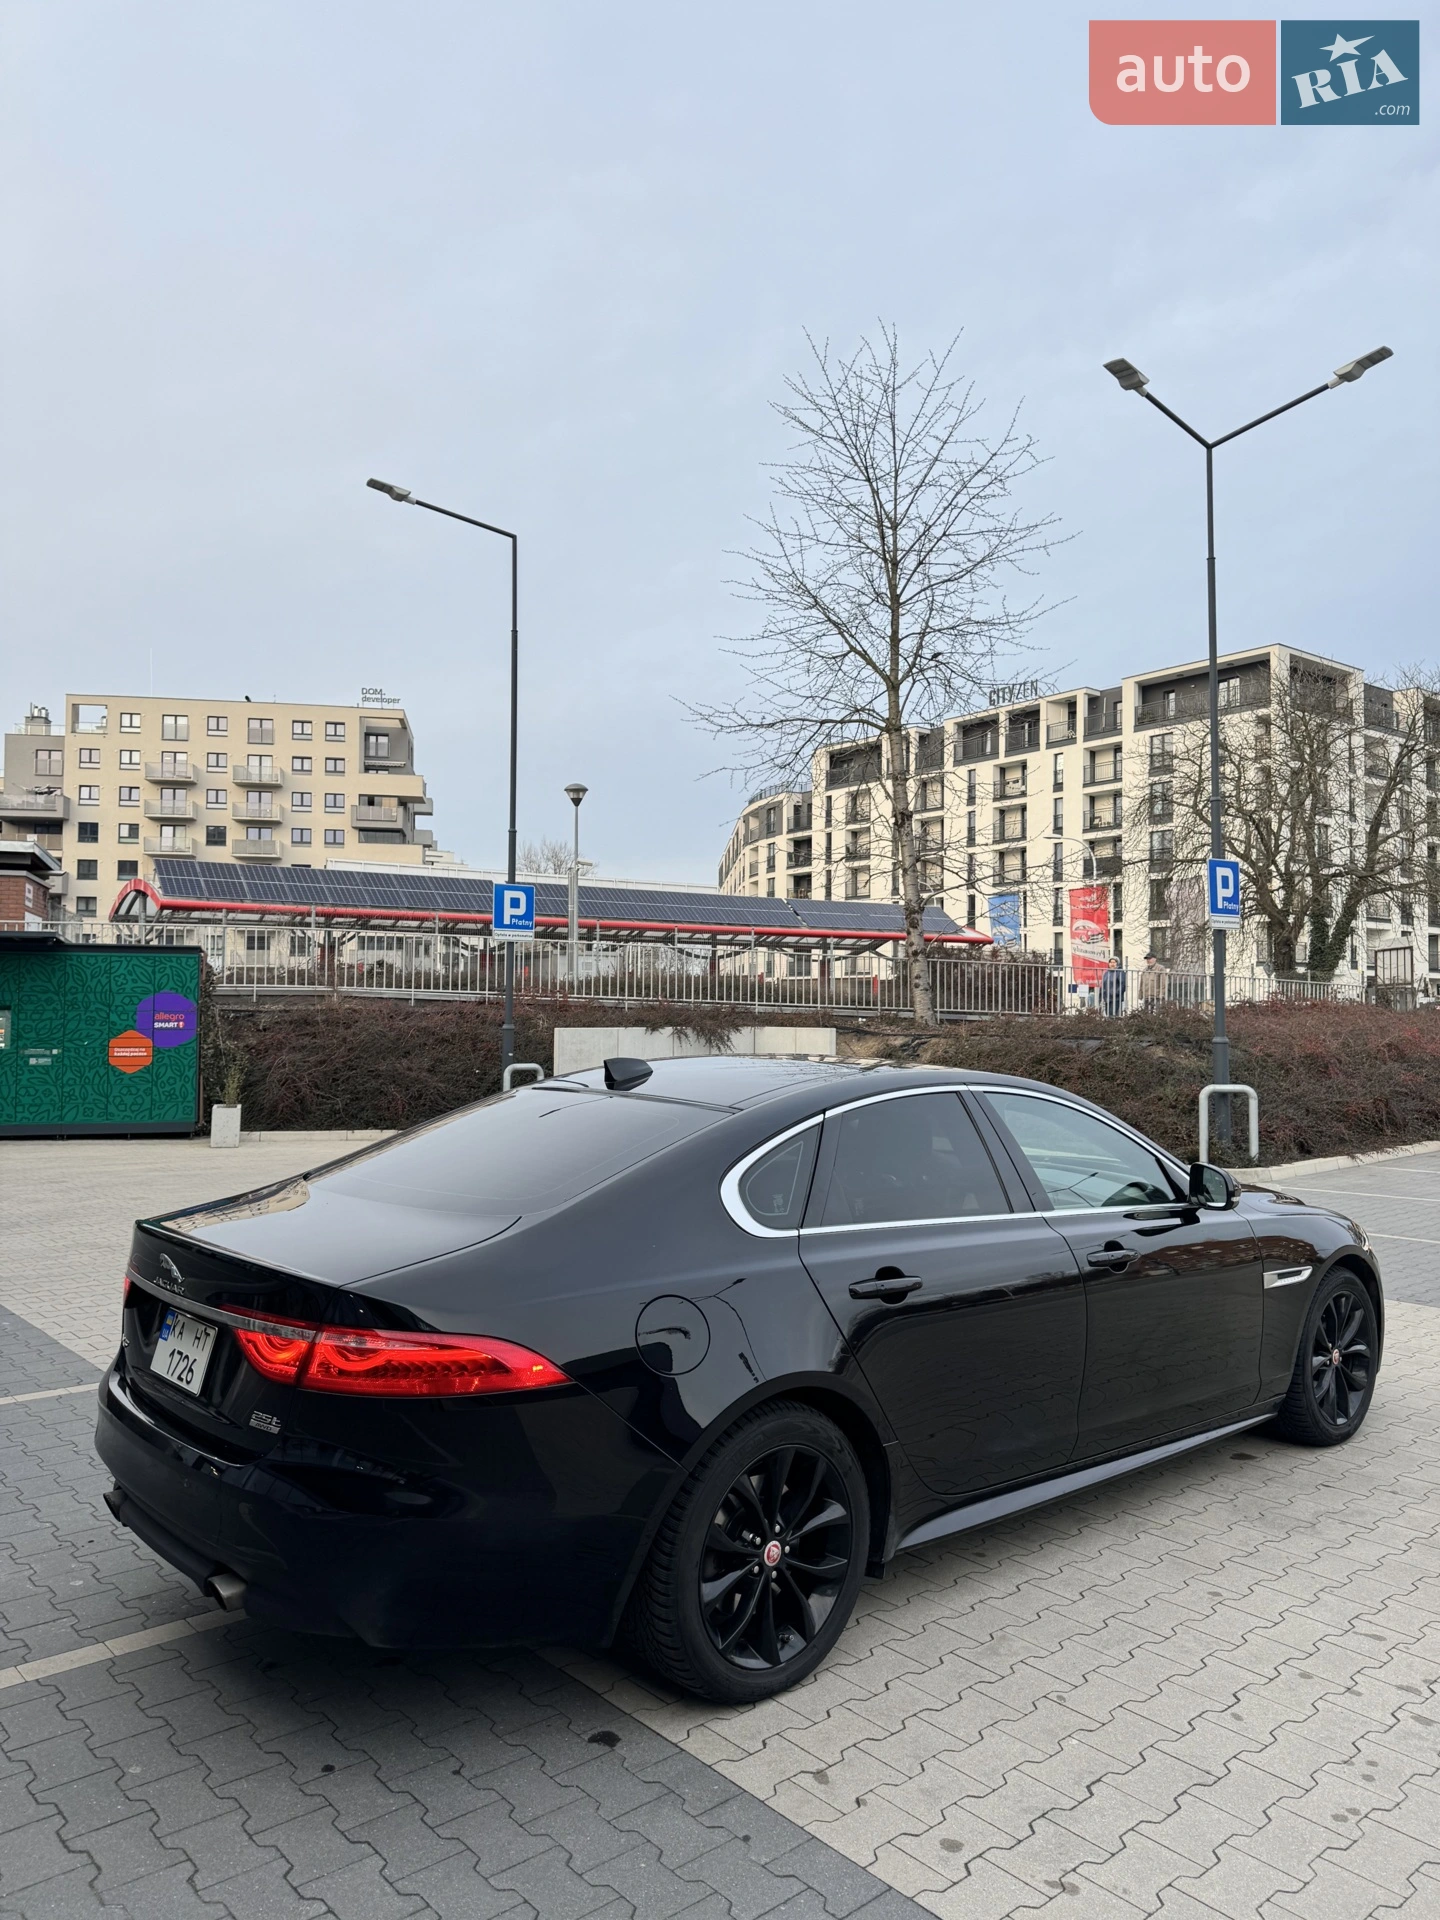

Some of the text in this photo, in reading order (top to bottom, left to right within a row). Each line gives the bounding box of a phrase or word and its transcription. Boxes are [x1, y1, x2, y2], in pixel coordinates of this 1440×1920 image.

[1216, 866, 1235, 909] P
[503, 890, 527, 925] P
[154, 1012, 185, 1022] allegro
[153, 1276, 185, 1295] JAGUAR
[167, 1348, 197, 1385] 1726
[252, 1410, 281, 1427] 25t
